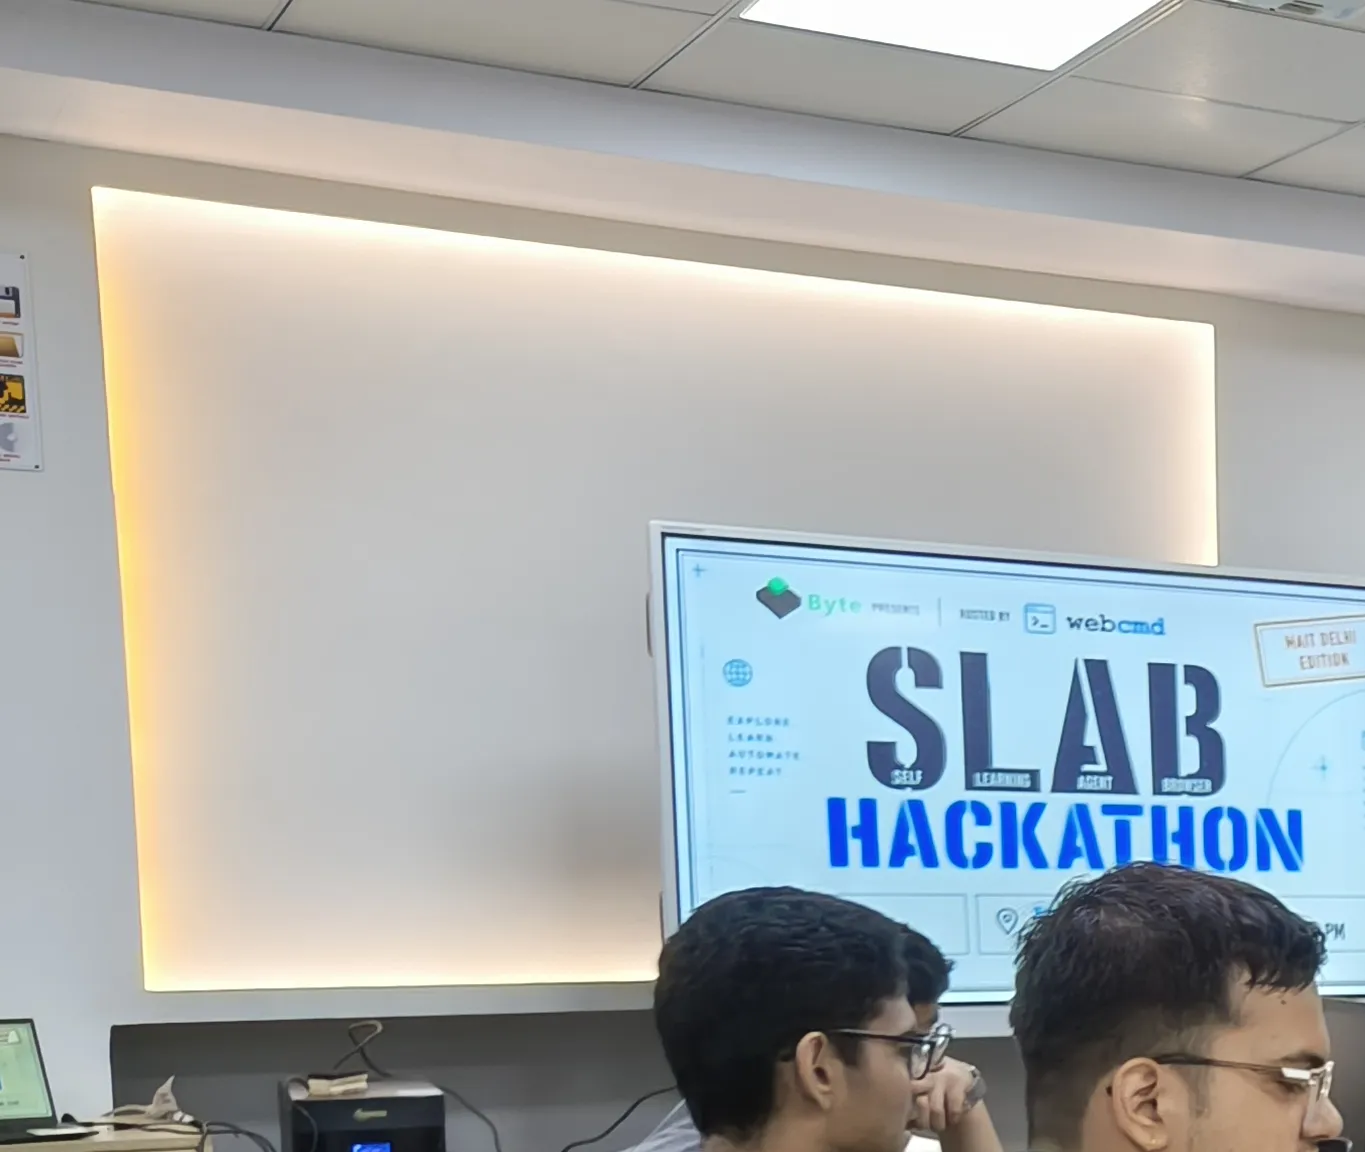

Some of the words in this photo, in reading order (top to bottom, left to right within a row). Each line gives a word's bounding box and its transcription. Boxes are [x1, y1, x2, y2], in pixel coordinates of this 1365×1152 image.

[808, 594, 862, 616] Byte
[1066, 613, 1166, 636] webcmd
[1320, 630, 1357, 646] DELHI
[1300, 653, 1350, 670] EDITION
[866, 646, 1227, 797] SLAB
[890, 770, 924, 786] SELF
[1076, 775, 1114, 791] AGENT
[827, 797, 1304, 873] HACKATHON
[1325, 923, 1347, 941] PM
